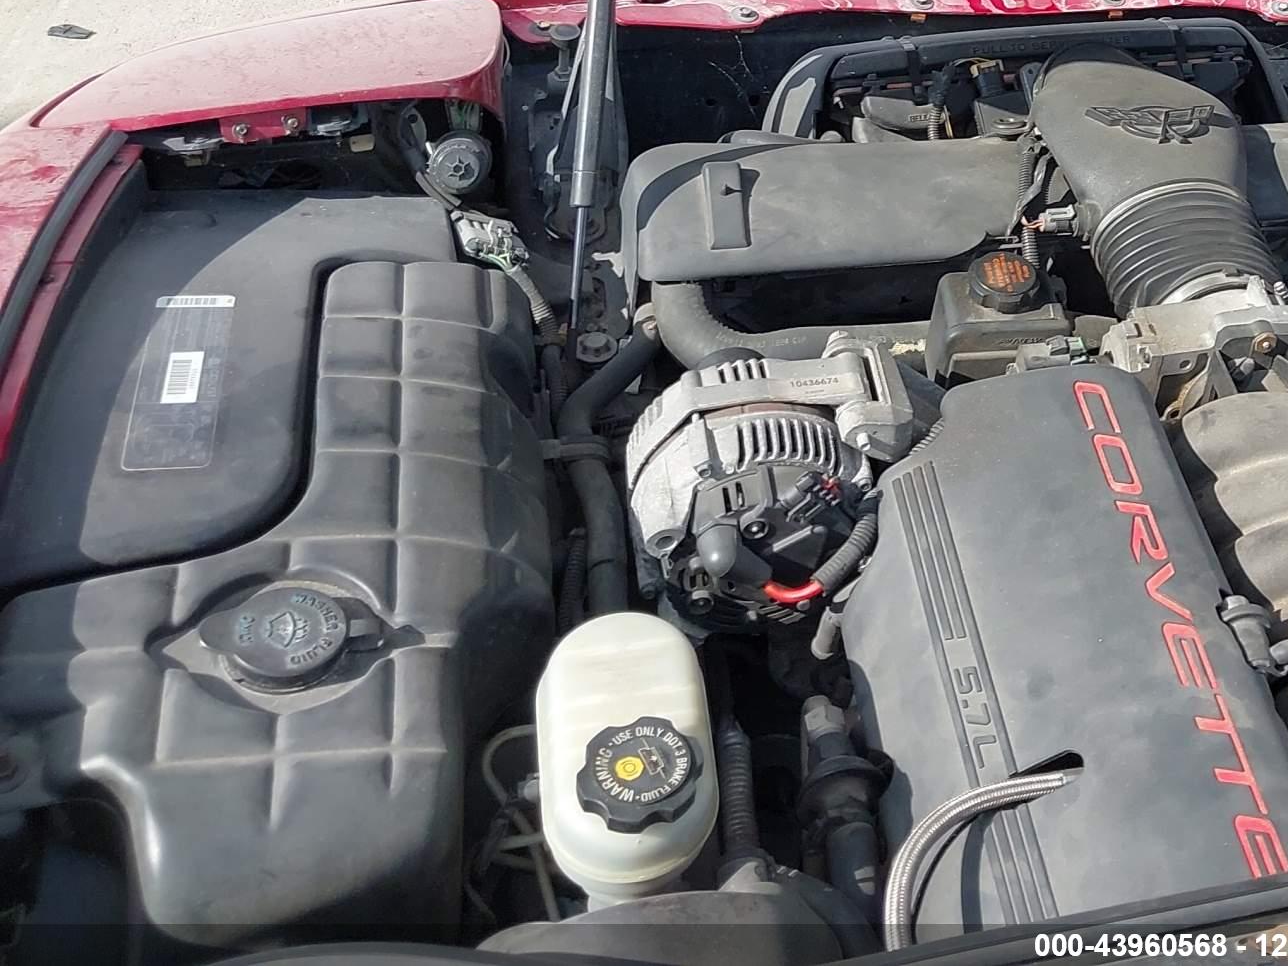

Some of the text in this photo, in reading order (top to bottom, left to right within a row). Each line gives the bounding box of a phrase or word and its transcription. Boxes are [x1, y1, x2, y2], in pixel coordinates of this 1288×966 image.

[289, 593, 339, 666] WASHER FLUID
[953, 665, 997, 769] 5.7L
[595, 726, 688, 803] WARNING USE ONLY DOT 3 BRAKE FLUID
